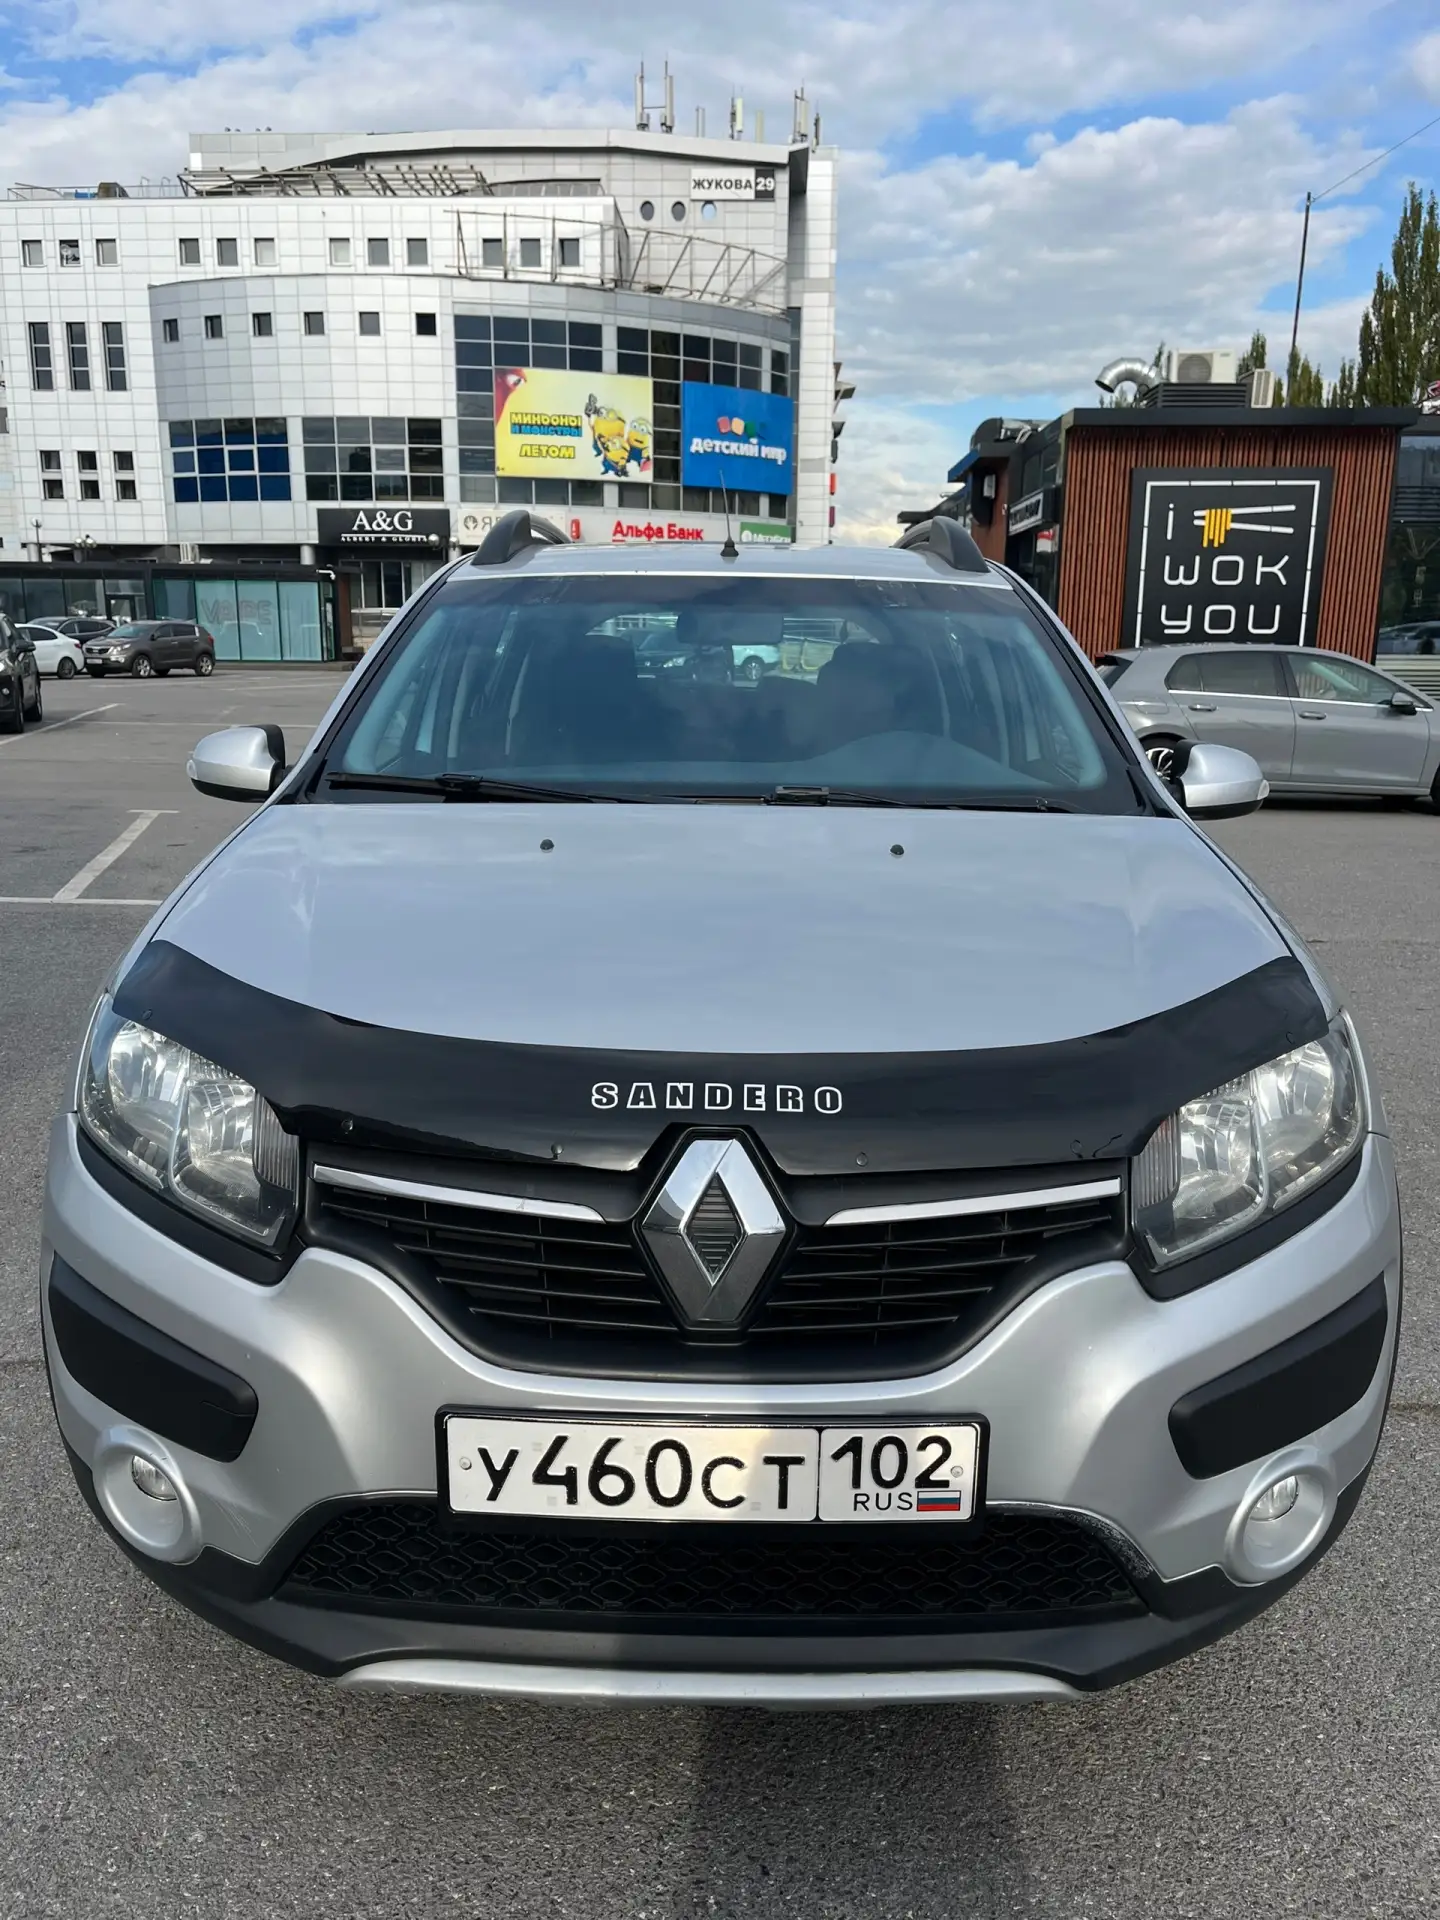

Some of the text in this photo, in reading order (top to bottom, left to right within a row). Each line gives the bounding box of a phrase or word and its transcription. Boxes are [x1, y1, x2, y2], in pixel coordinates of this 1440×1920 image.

[692, 177, 775, 191] ЖУКОВА 29
[510, 412, 582, 426] МИНЬОНЫ
[521, 425, 582, 437] МОНСТРЫ
[519, 444, 575, 459] ЛЕТОМ
[352, 510, 413, 531] A&G
[612, 520, 704, 541] Альфа Банк
[591, 1082, 842, 1114] SANDERO
[830, 1435, 953, 1490] 102
[853, 1493, 914, 1512] RUS
